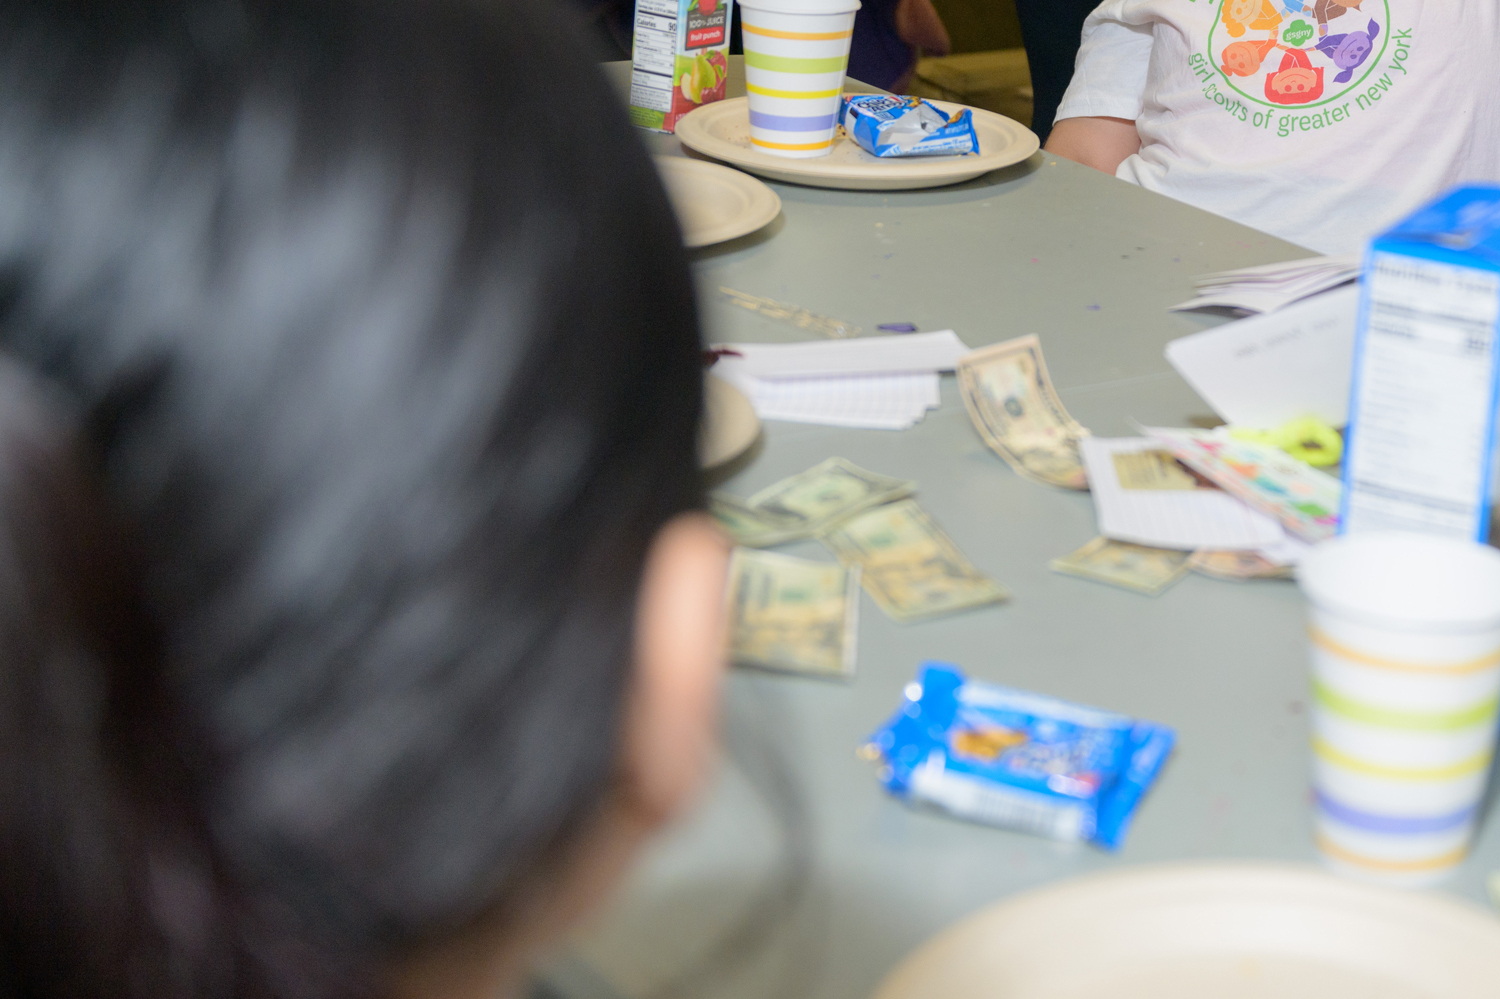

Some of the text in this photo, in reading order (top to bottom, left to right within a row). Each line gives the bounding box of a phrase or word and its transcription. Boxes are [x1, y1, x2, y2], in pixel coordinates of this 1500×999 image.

[706, 15, 724, 27] JUICE
[1285, 28, 1312, 41] gsgny
[1188, 52, 1216, 84] girl
[1252, 108, 1275, 129] of
[1276, 102, 1351, 138] greater
[1354, 72, 1395, 111] new
[1388, 27, 1413, 76] york
